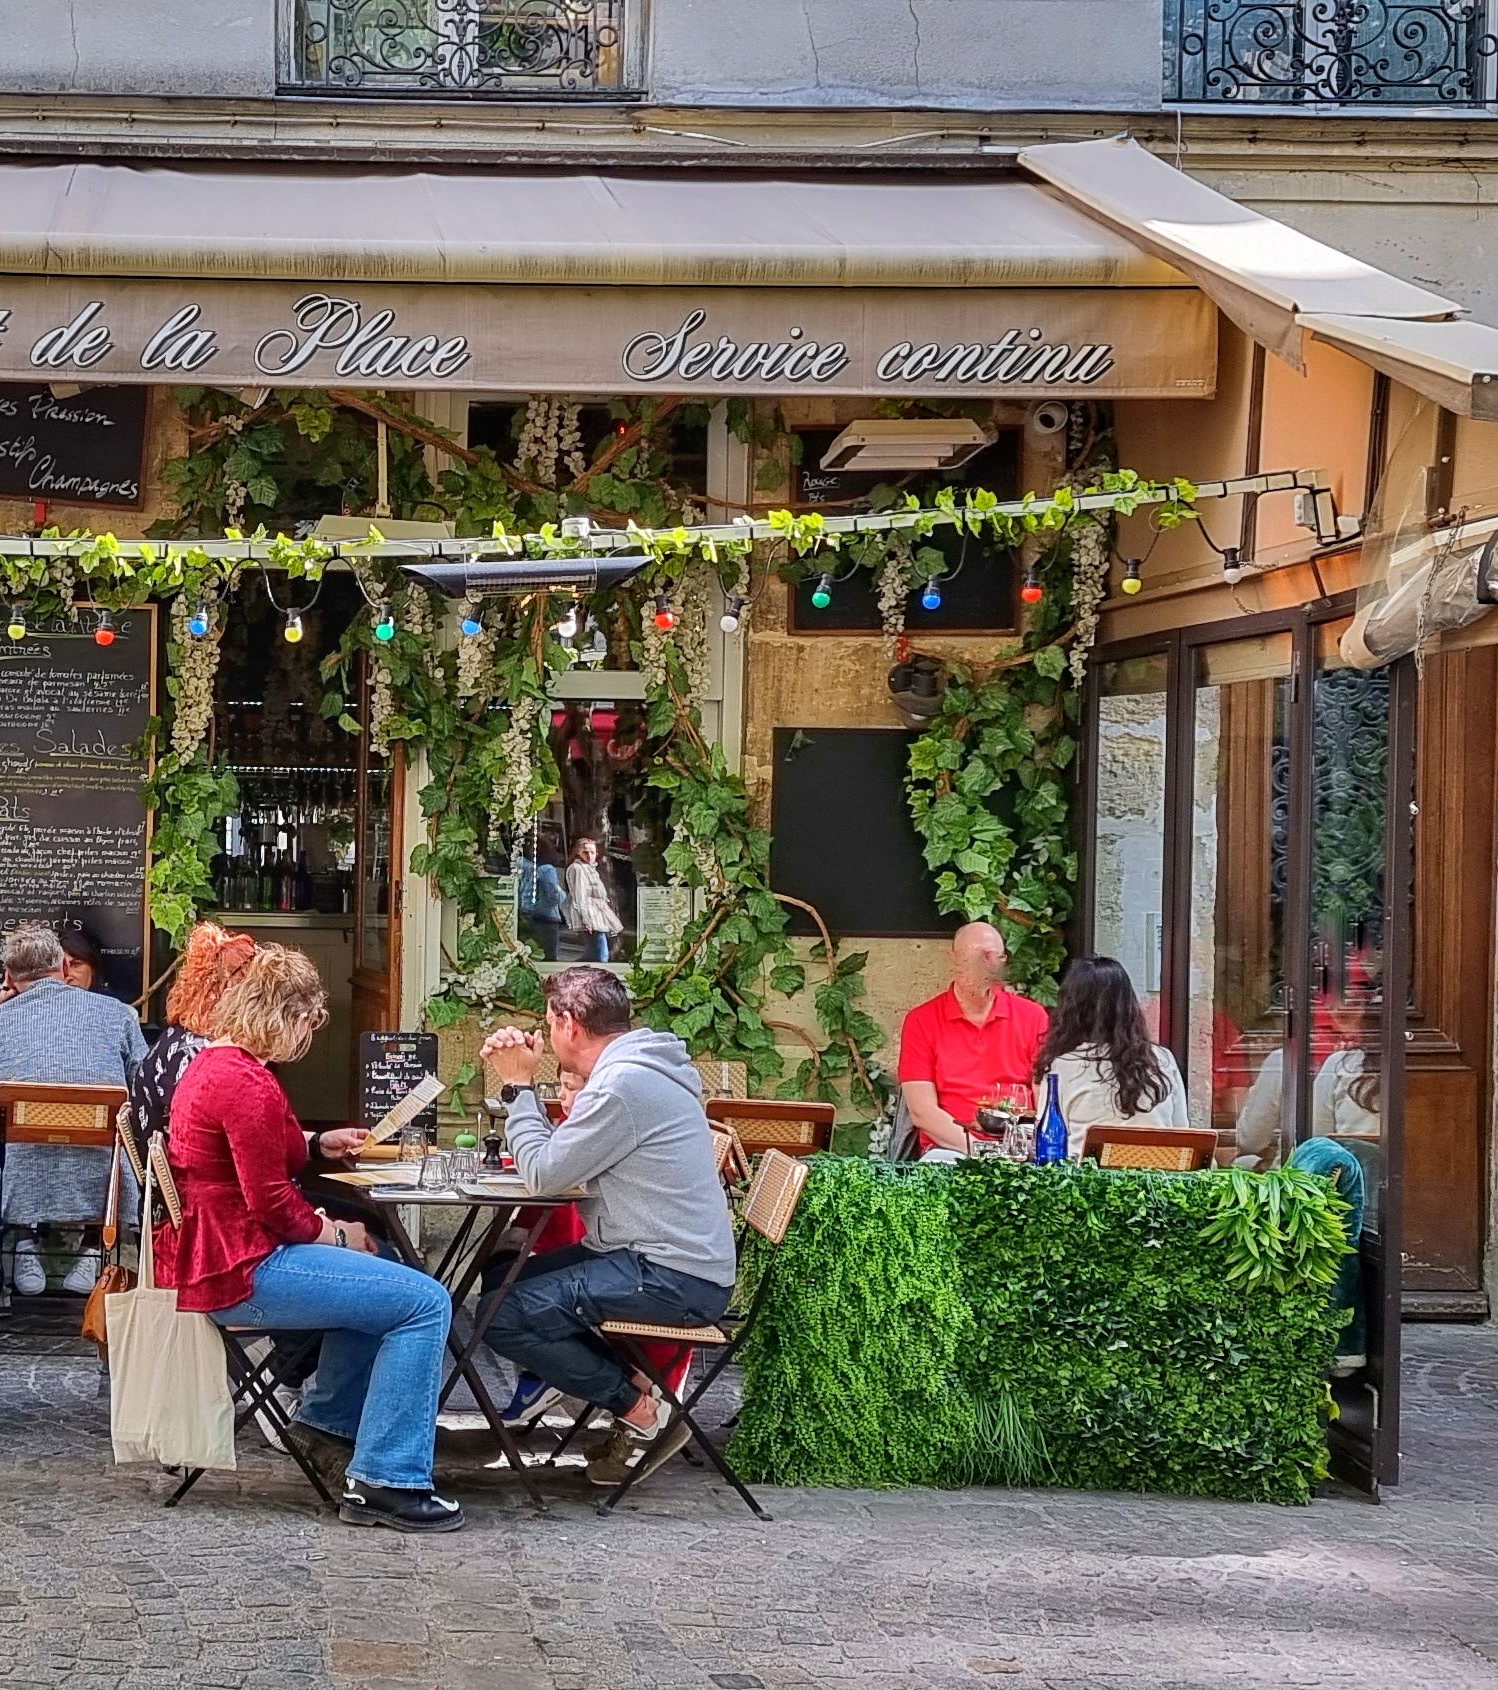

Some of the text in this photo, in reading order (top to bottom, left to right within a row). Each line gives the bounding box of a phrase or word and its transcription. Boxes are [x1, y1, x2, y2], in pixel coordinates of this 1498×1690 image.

[30, 300, 112, 369] de
[139, 302, 219, 371] la
[253, 292, 472, 377] Place
[622, 308, 1115, 386] Service continu
[29, 394, 116, 425] Pression
[29, 454, 138, 499] Champagnes
